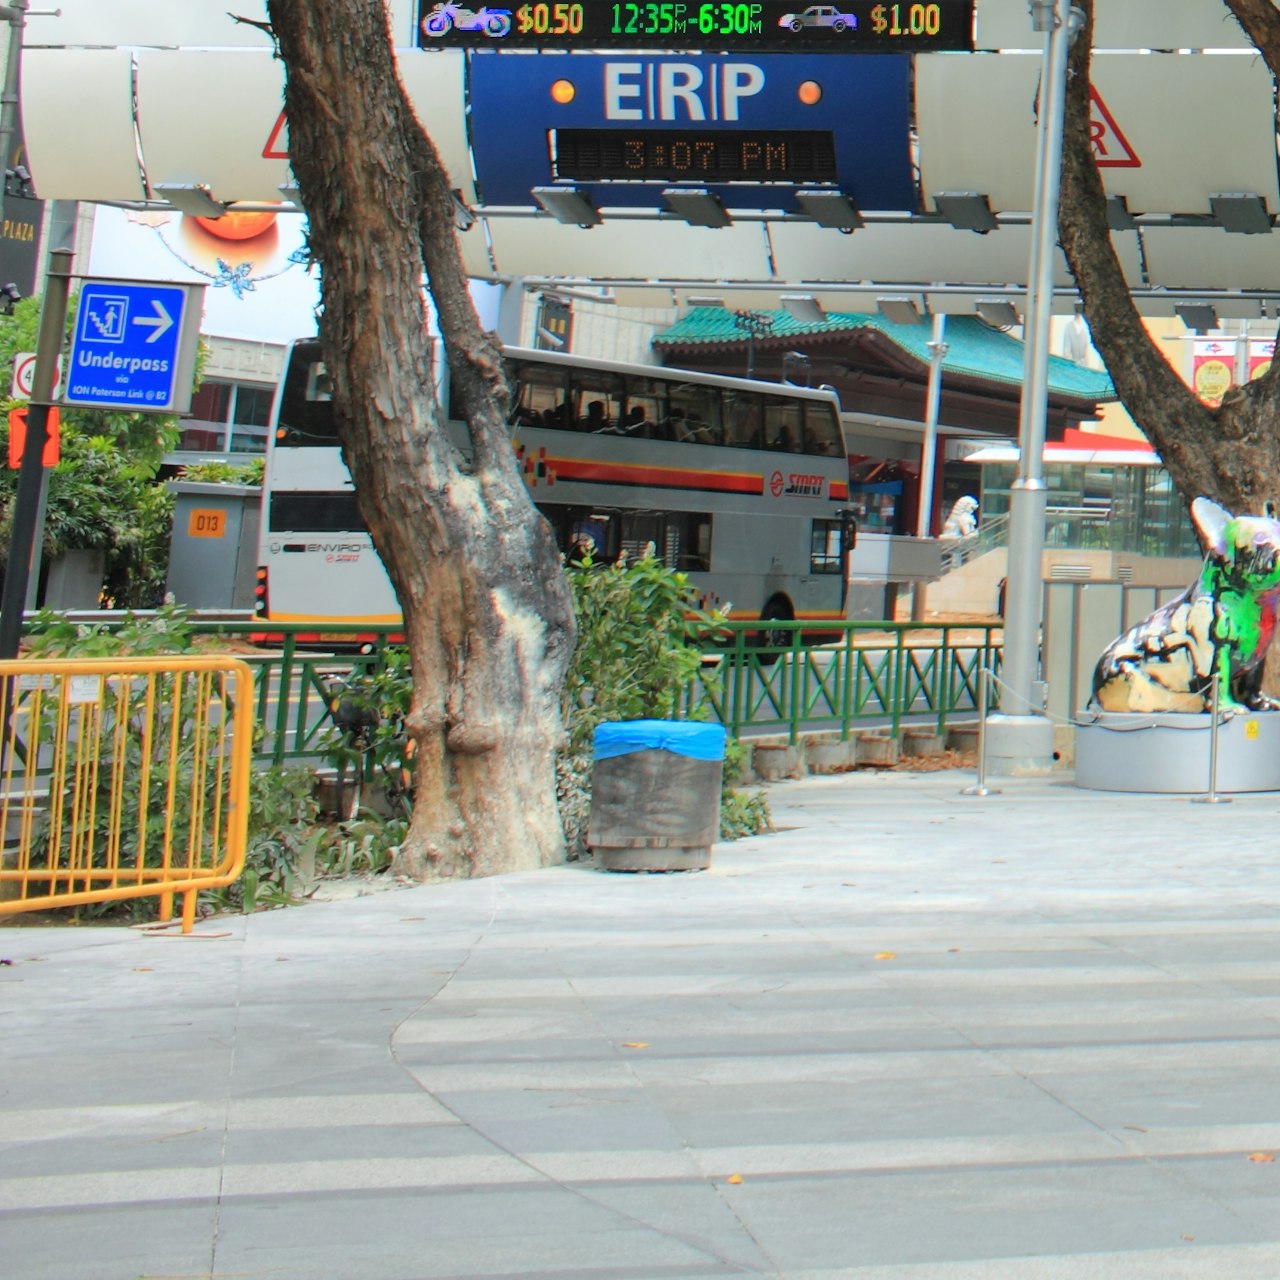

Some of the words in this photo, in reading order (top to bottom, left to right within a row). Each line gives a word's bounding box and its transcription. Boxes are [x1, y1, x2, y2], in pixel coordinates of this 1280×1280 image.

[517, 3, 584, 34] $0.50
[871, 3, 941, 35] $1.00
[625, 141, 714, 170] 3:07
[743, 142, 786, 170] PM
[3, 219, 34, 241] PLAZA
[78, 350, 169, 373] Underpass
[115, 375, 130, 384] via
[72, 386, 90, 396] ION
[91, 388, 126, 399] Paterson
[127, 389, 144, 399] Link
[156, 391, 167, 401] B2
